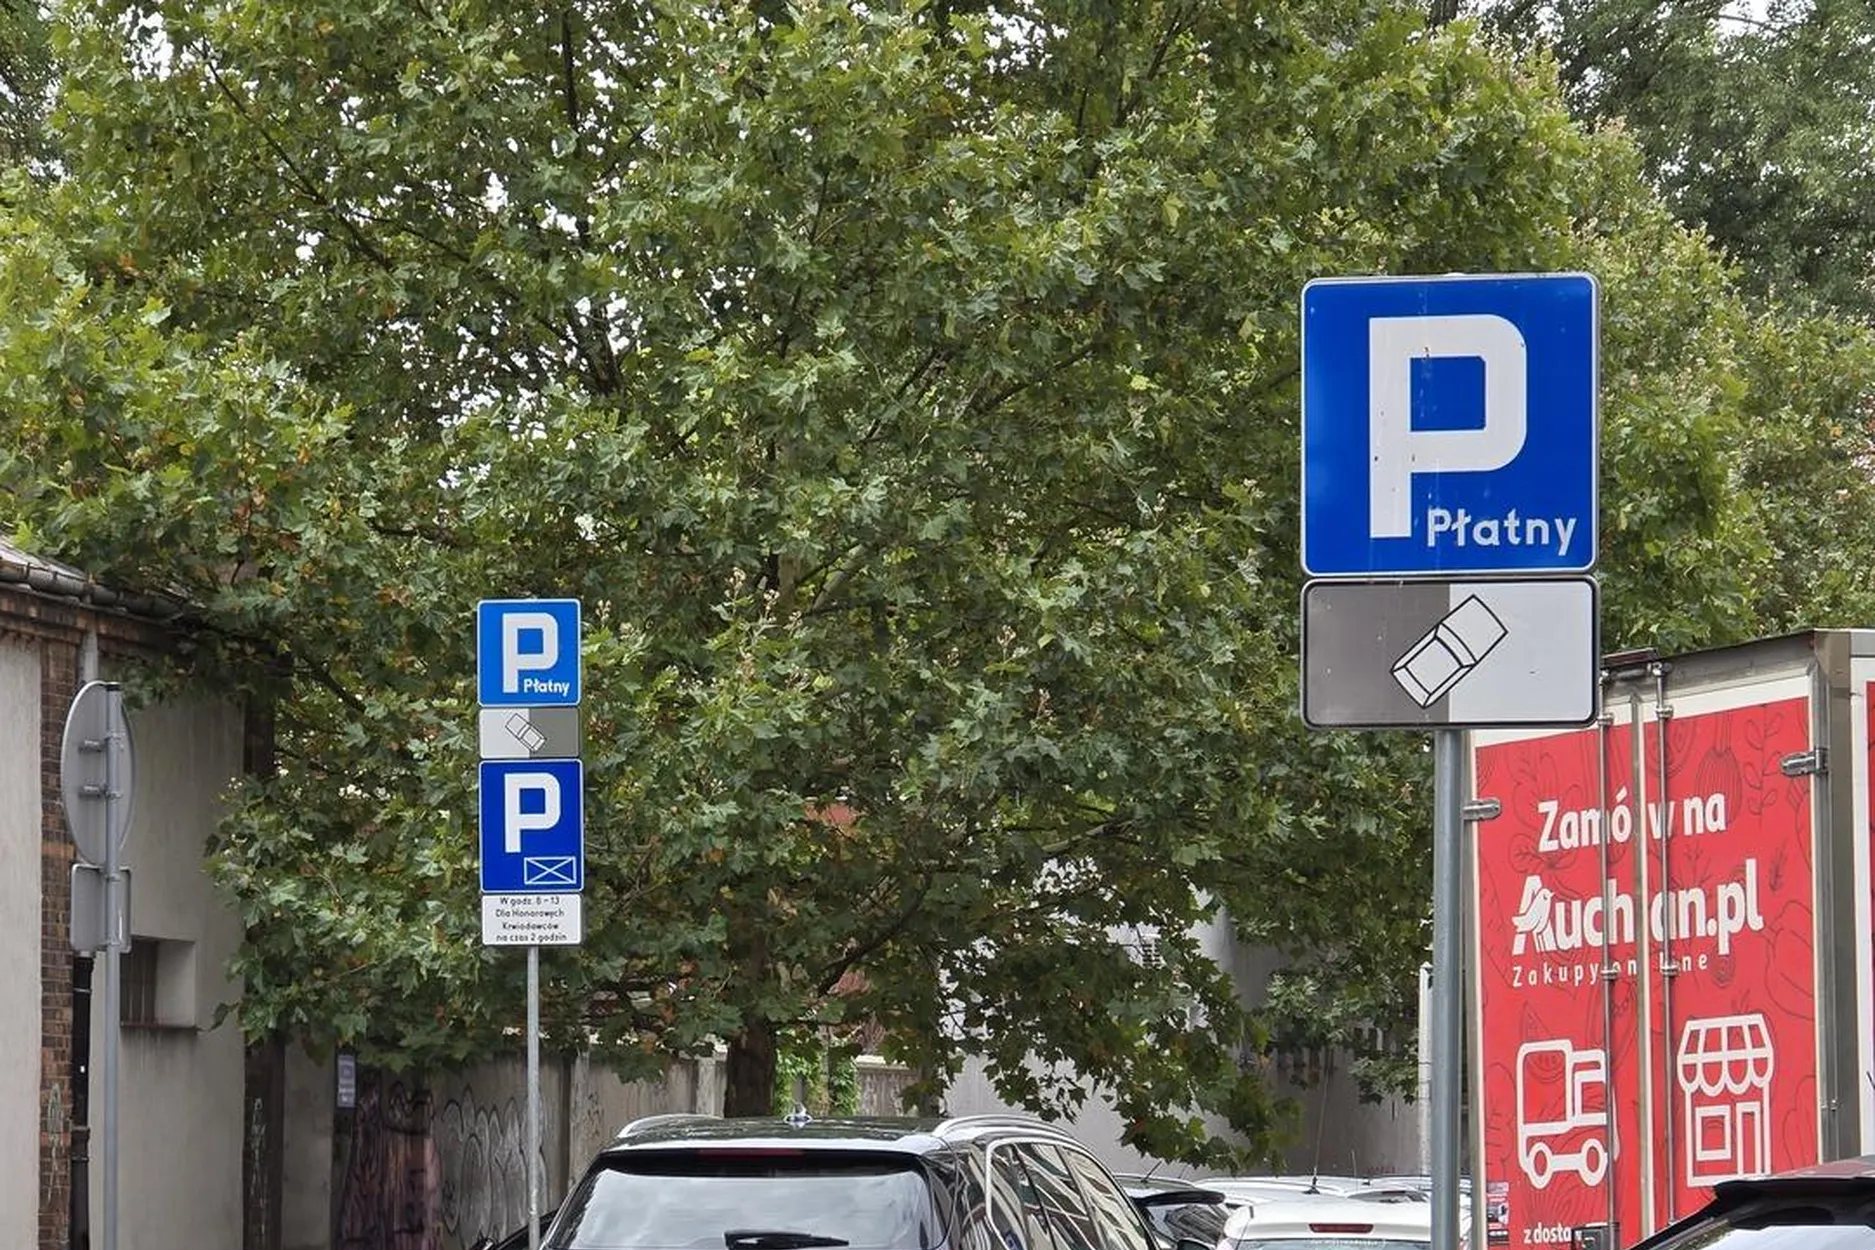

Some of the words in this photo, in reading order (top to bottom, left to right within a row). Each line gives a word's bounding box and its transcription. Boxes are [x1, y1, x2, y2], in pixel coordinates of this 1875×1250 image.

[1369, 314, 1527, 538] P
[1427, 506, 1577, 556] Płatny
[503, 612, 559, 693] P
[523, 678, 570, 697] Płatny
[504, 773, 561, 853] P
[1538, 786, 1675, 852] Zamów
[1683, 793, 1726, 836] na
[500, 896, 509, 905] W
[1512, 858, 1764, 955] Auchan.pl
[1512, 962, 1599, 988] Zakupy
[1523, 1229, 1532, 1244] z
